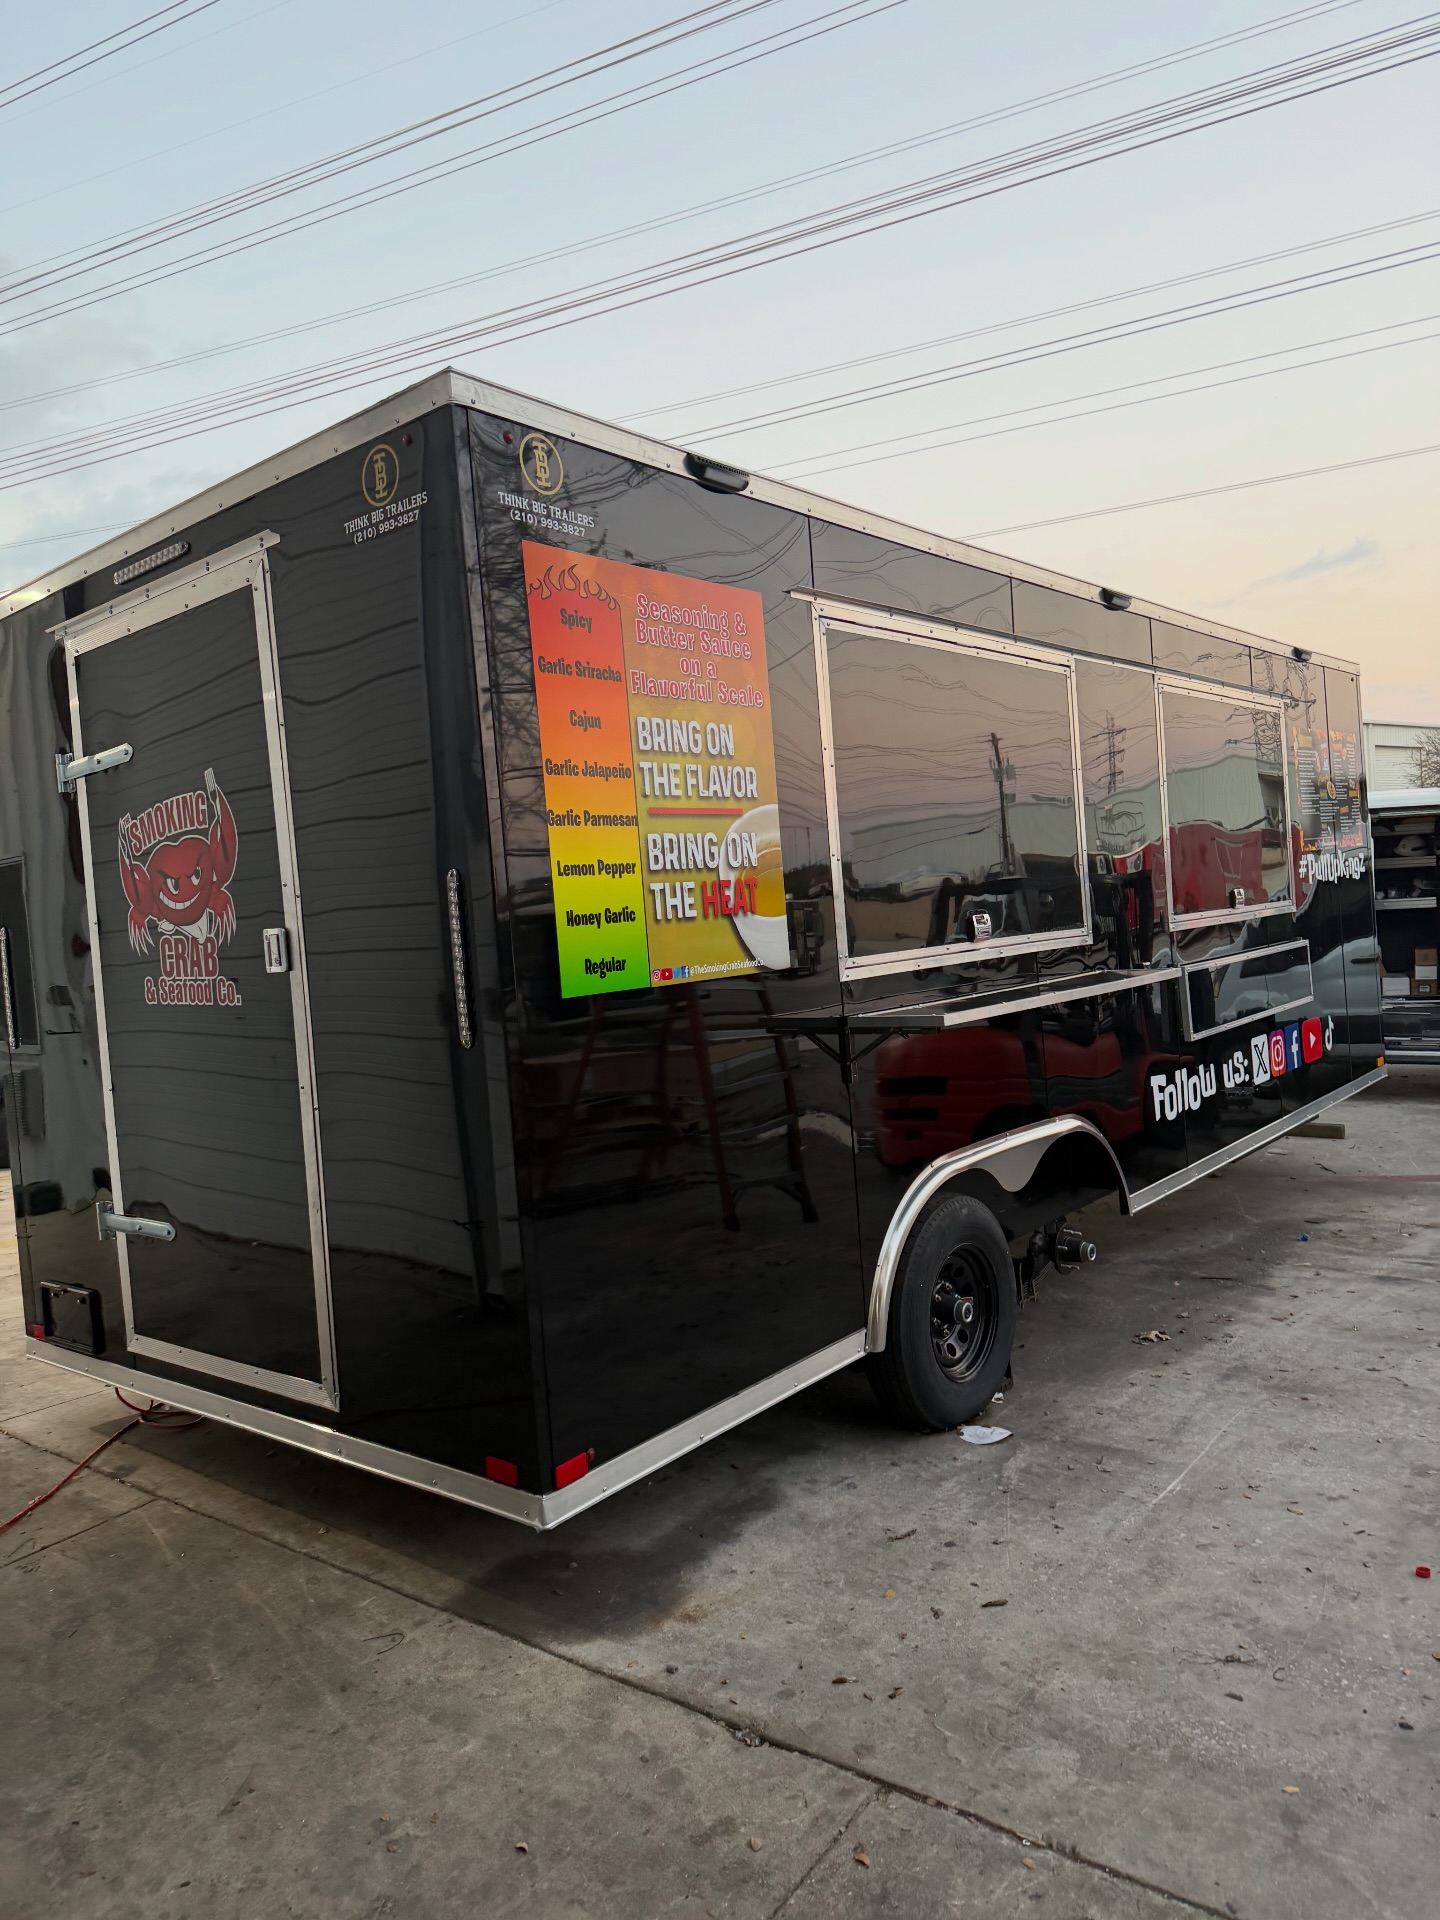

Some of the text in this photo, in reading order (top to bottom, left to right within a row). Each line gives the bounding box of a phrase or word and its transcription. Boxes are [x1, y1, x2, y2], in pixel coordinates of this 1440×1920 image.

[344, 491, 428, 534] THINK BIG TRAILERS
[353, 510, 420, 545] (210) 993-3827
[498, 491, 595, 528] THINK BIG TRAILERS
[510, 509, 585, 538] (210) 993-3827
[560, 608, 592, 633] Spicy
[636, 593, 747, 638] Seasoning &
[635, 618, 752, 659] Butter Sauce
[537, 656, 622, 683] Garlic Sriracha
[679, 656, 717, 678] on a
[630, 670, 764, 707] Flavorful Scale
[569, 709, 601, 732] Cajun
[636, 717, 735, 756] BRING ON
[544, 758, 632, 782] Garlic Jalapeño
[639, 761, 758, 798] THE FLAVOR
[129, 791, 208, 856] SMOKING
[547, 809, 638, 827] Garlic Parmesan
[557, 859, 636, 878] Lemon Pepper
[647, 832, 758, 871] BRING ON
[566, 906, 636, 928] Honey Garlic
[650, 878, 758, 920] THE HEAT
[160, 935, 219, 979] CRAB
[584, 958, 627, 979] Regular
[145, 976, 242, 1006] & Seafood Co.
[1150, 1050, 1250, 1121] Follow us:
